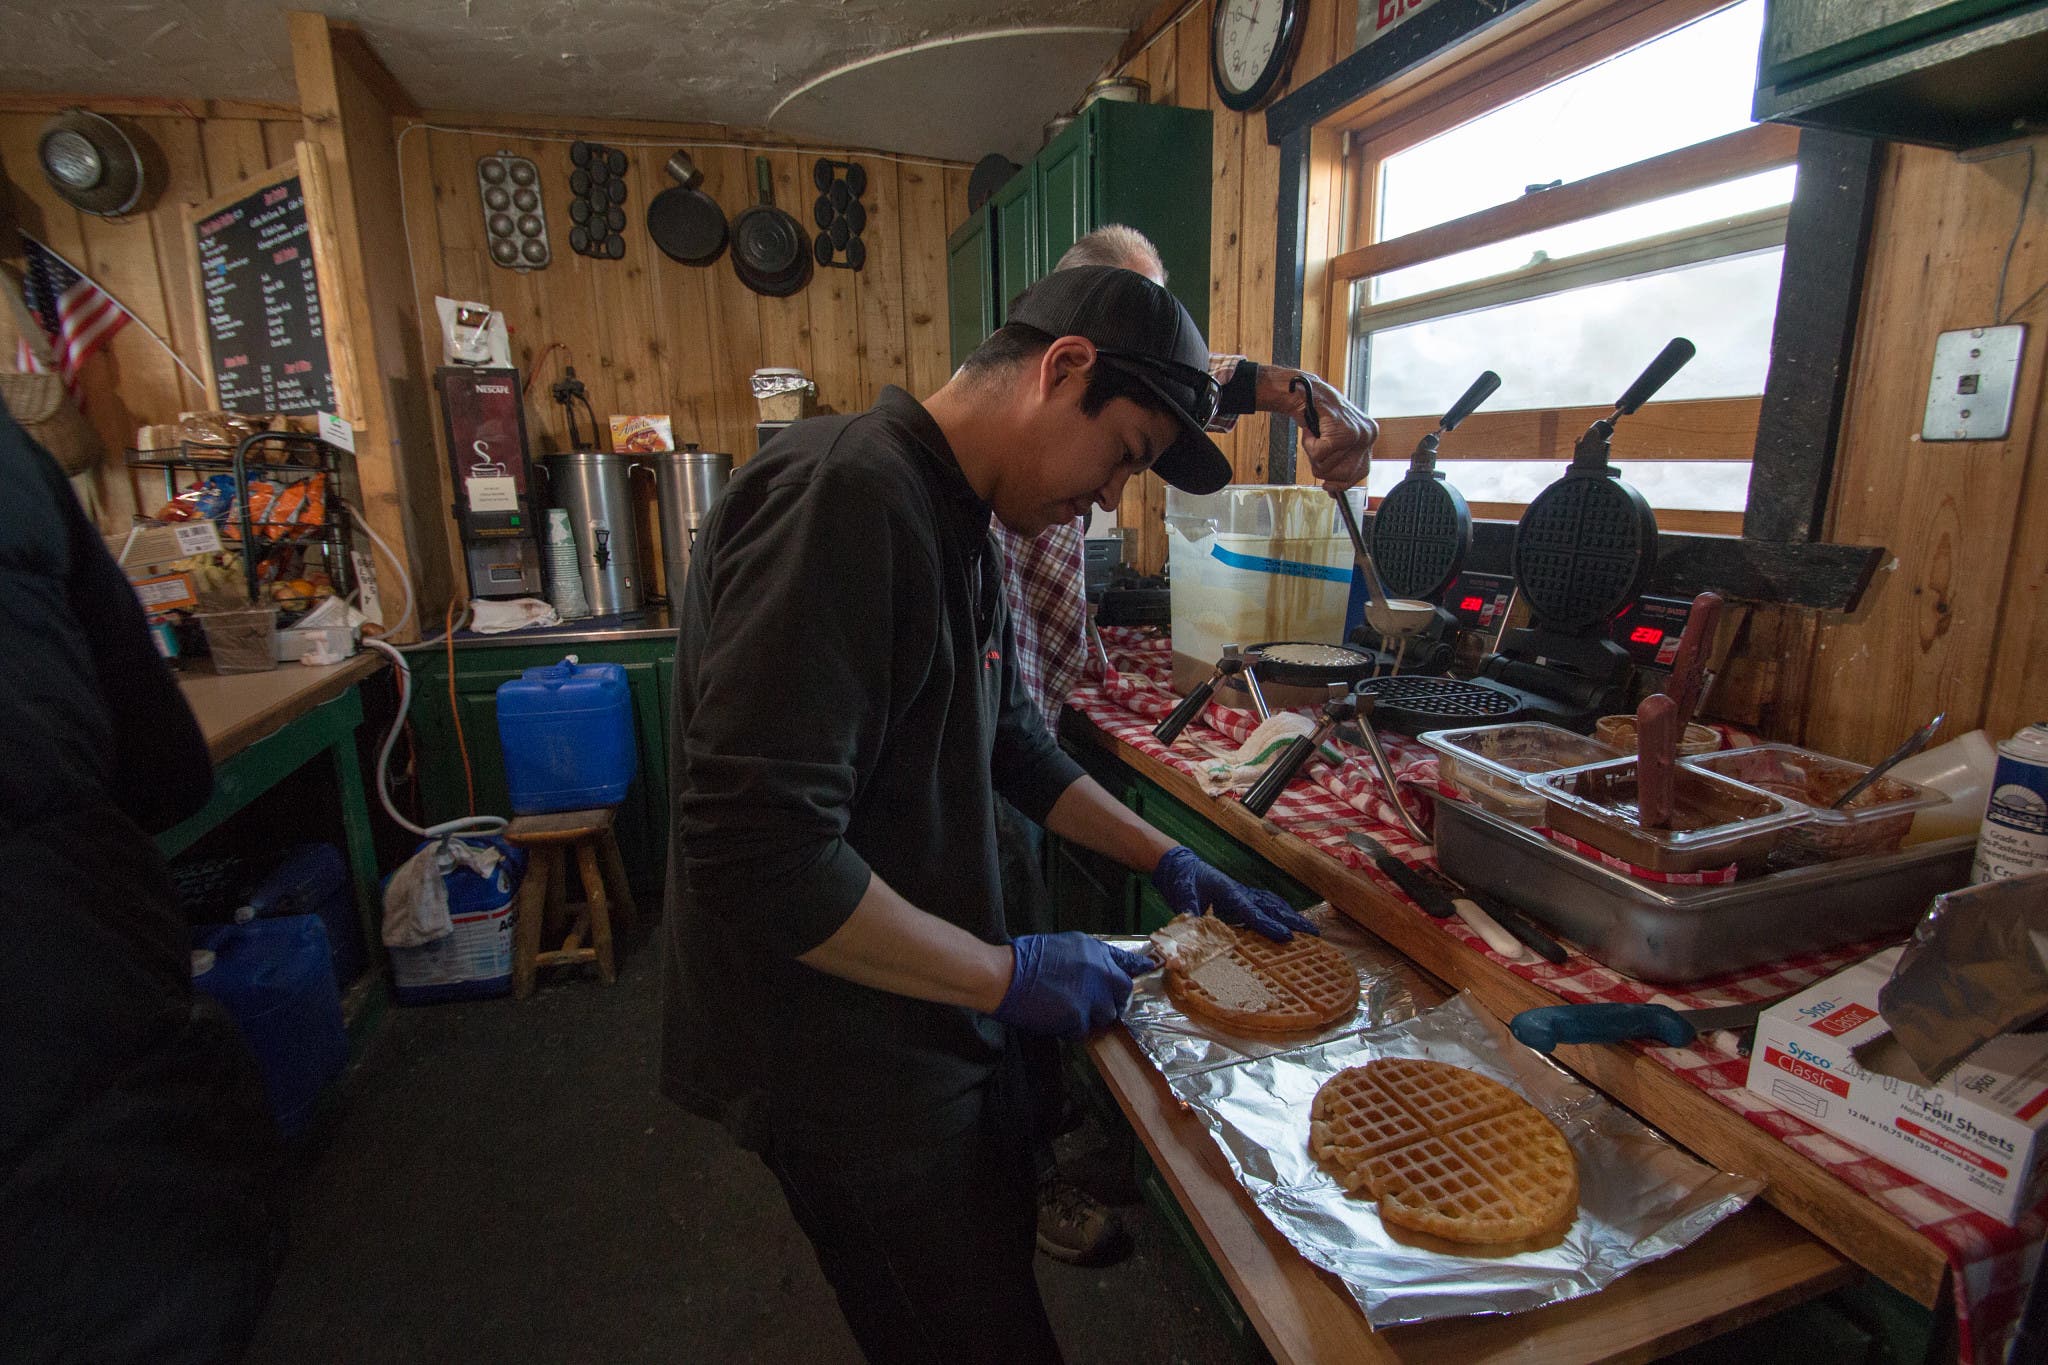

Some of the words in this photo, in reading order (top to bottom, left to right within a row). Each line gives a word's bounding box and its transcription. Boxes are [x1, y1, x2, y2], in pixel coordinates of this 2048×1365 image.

[1630, 625, 1664, 645] 230
[1799, 1001, 1836, 1018] Sysco
[1822, 1010, 1870, 1032] Classic
[1788, 1042, 1831, 1069] Sysco
[1778, 1055, 1834, 1092] Classic
[1848, 1108, 1858, 1118] 12
[1923, 1101, 1953, 1123] Foil
[1956, 1118, 2015, 1153] Sheets
